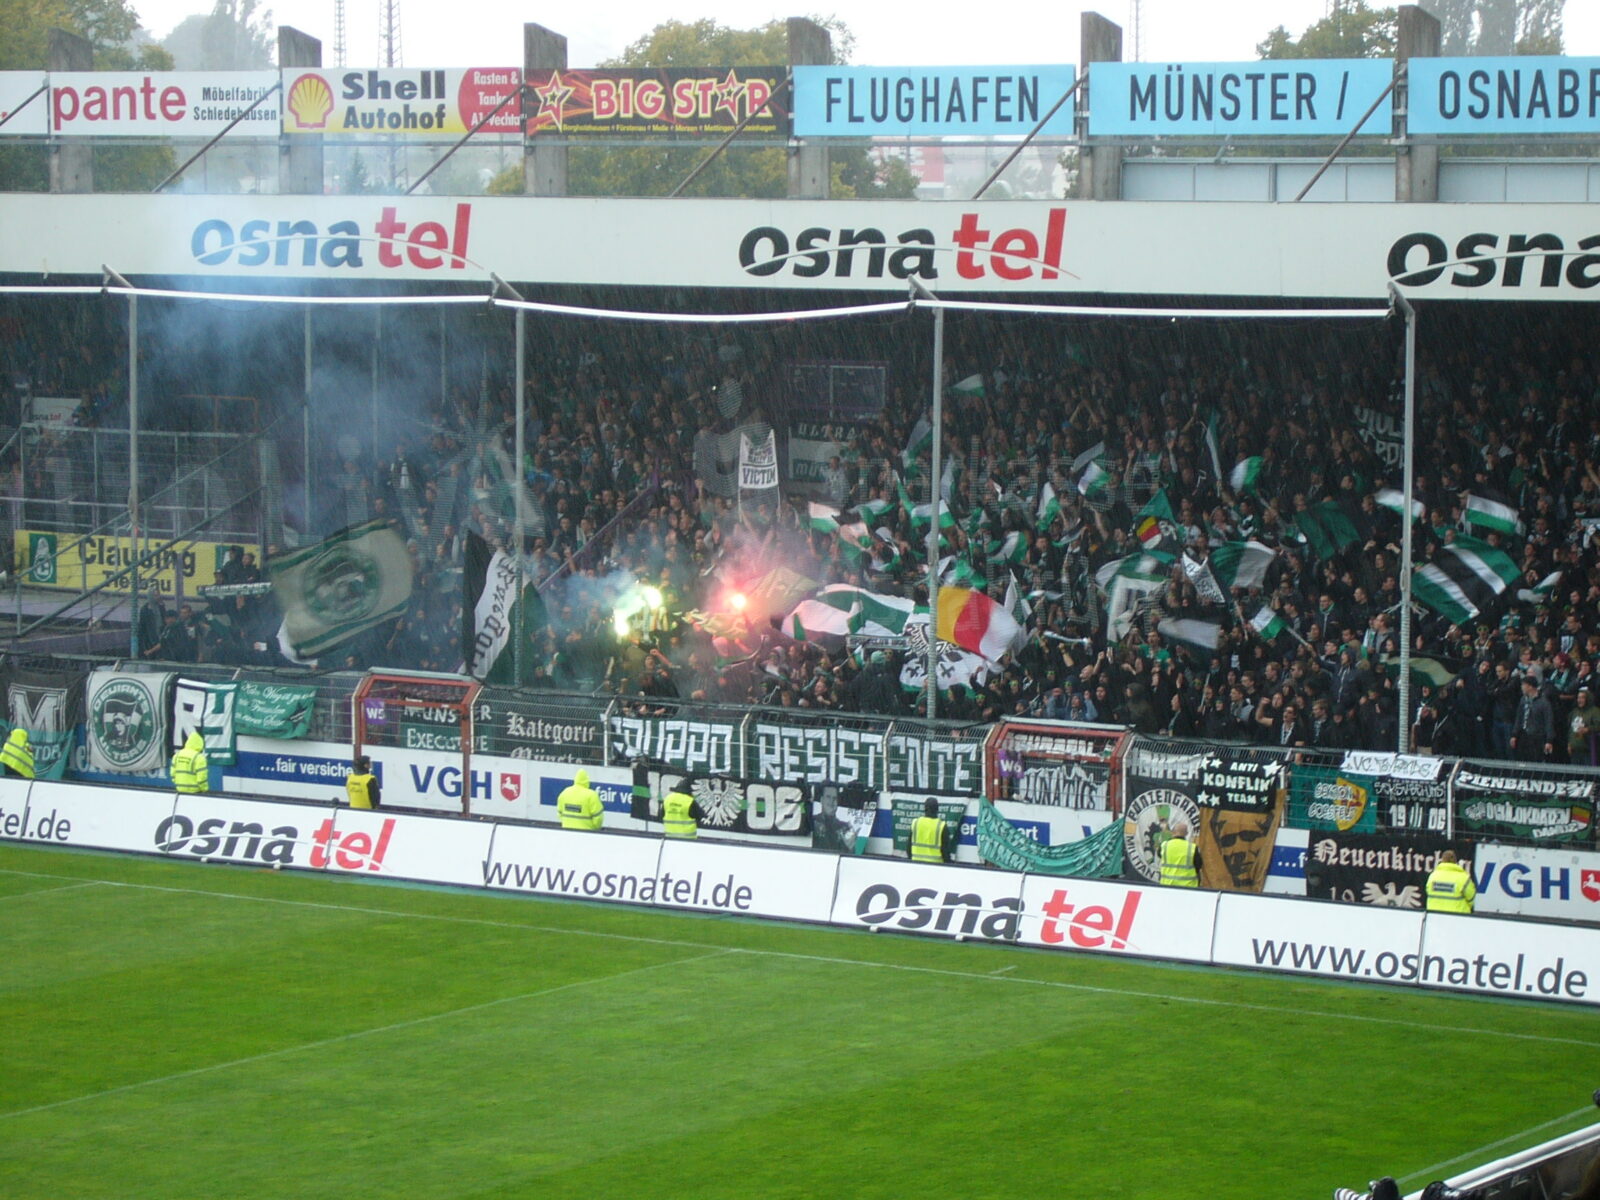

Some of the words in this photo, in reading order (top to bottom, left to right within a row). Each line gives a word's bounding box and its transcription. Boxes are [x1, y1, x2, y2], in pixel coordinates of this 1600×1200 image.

[342, 70, 446, 100] Shell
[473, 71, 507, 85] Rasten
[511, 71, 518, 84] &
[592, 79, 666, 119] BIG
[825, 76, 1040, 123] FLUGHAFEN
[1129, 64, 1317, 122] MÜNSTER
[54, 77, 186, 130] pante
[342, 106, 447, 130] Autohof
[191, 203, 473, 270] osnatel
[738, 208, 1067, 280] osnatel
[409, 764, 493, 800] VGH
[1001, 760, 1022, 773] W6
[1229, 763, 1259, 773] ANTI
[1226, 793, 1258, 805] TEAM
[154, 813, 396, 871] osnatel
[482, 860, 753, 910] www.osnatel.de
[1476, 861, 1571, 901] VGH
[855, 884, 1142, 949] osnatel
[1251, 937, 1588, 998] www.osnatel.de
